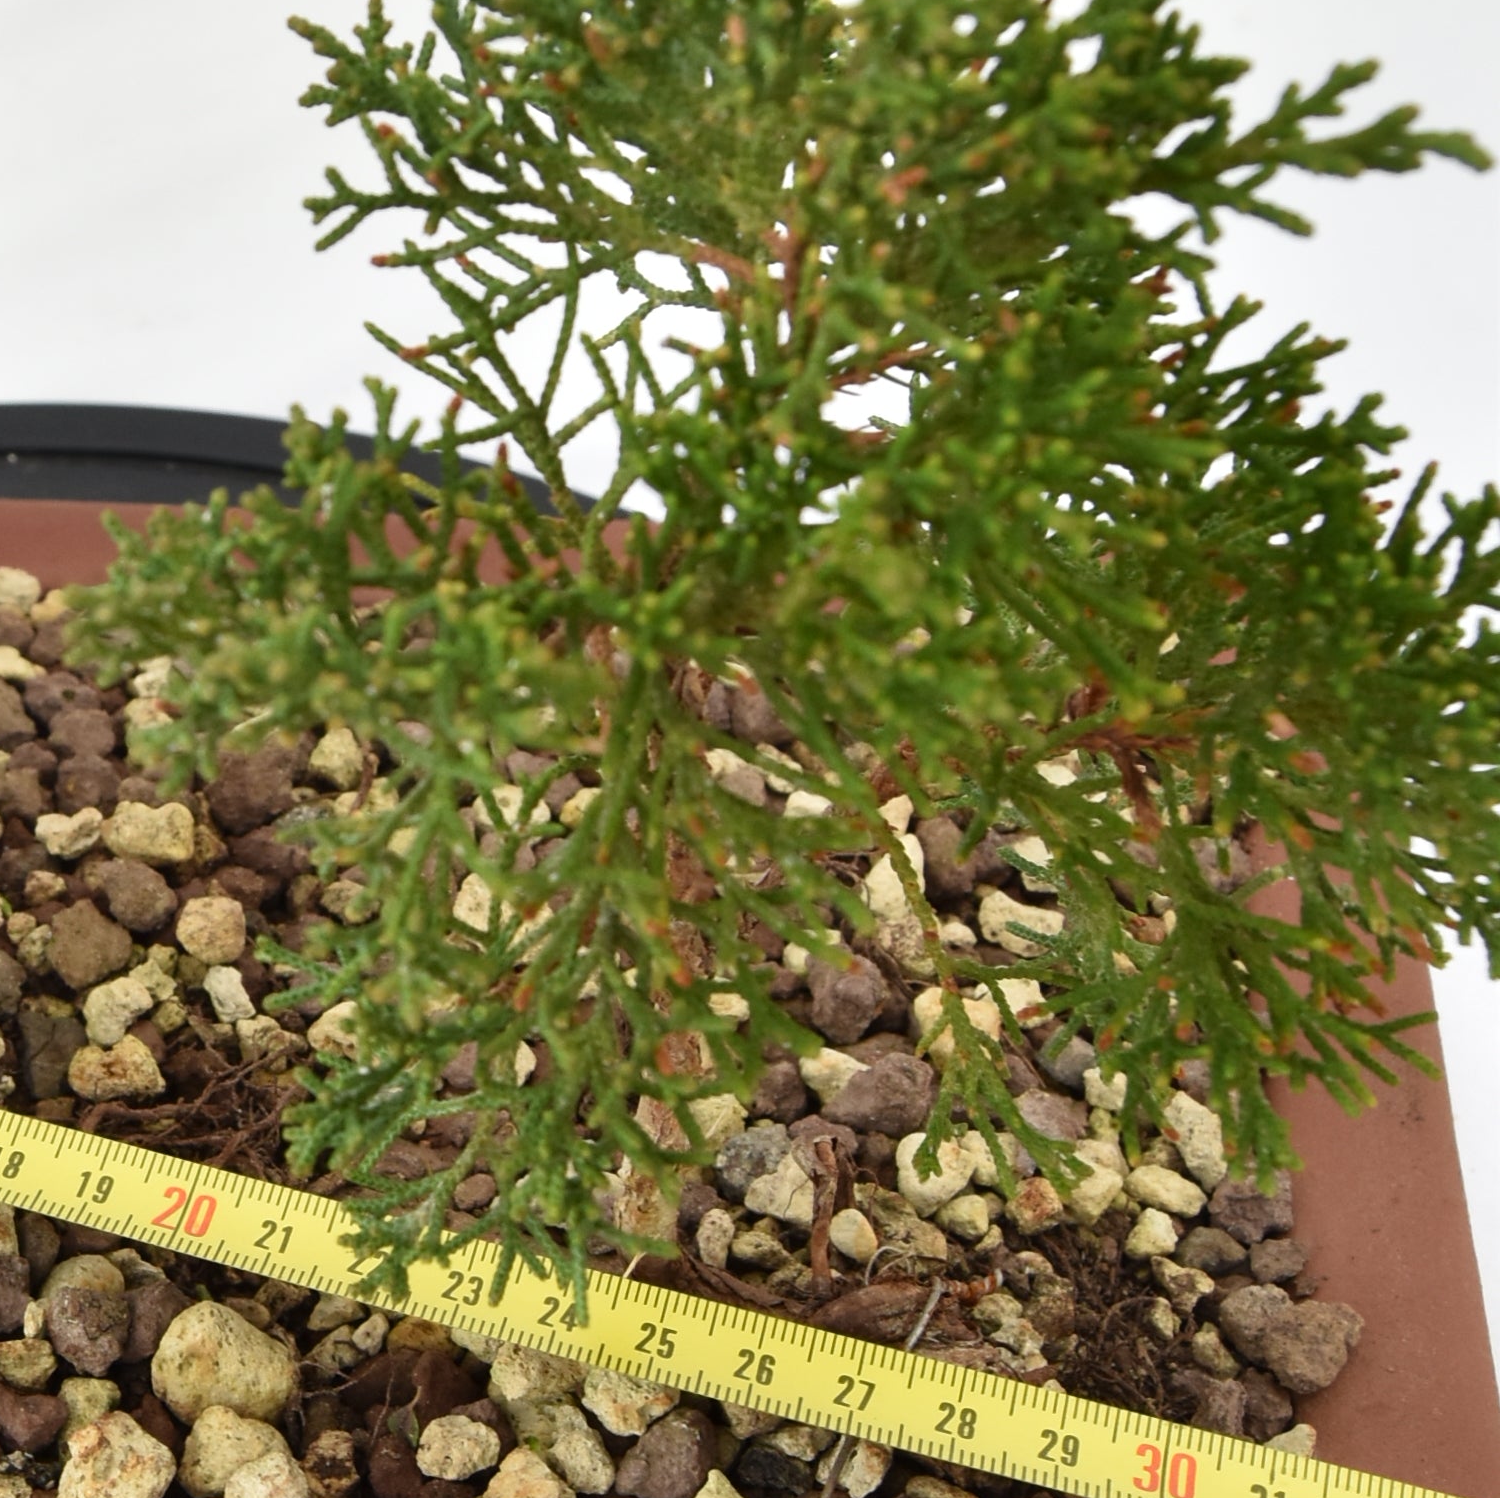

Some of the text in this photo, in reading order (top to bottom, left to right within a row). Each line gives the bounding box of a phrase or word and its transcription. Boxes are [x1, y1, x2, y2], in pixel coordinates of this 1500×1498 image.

[75, 1171, 115, 1204] 19
[151, 1186, 218, 1238] 20
[254, 1219, 293, 1255] 21
[440, 1270, 484, 1306] 23
[537, 1296, 578, 1332] 24
[634, 1322, 678, 1360] 25
[733, 1348, 776, 1386] 26
[833, 1374, 876, 1411] 27
[935, 1402, 978, 1440] 28
[1037, 1429, 1081, 1467] 29
